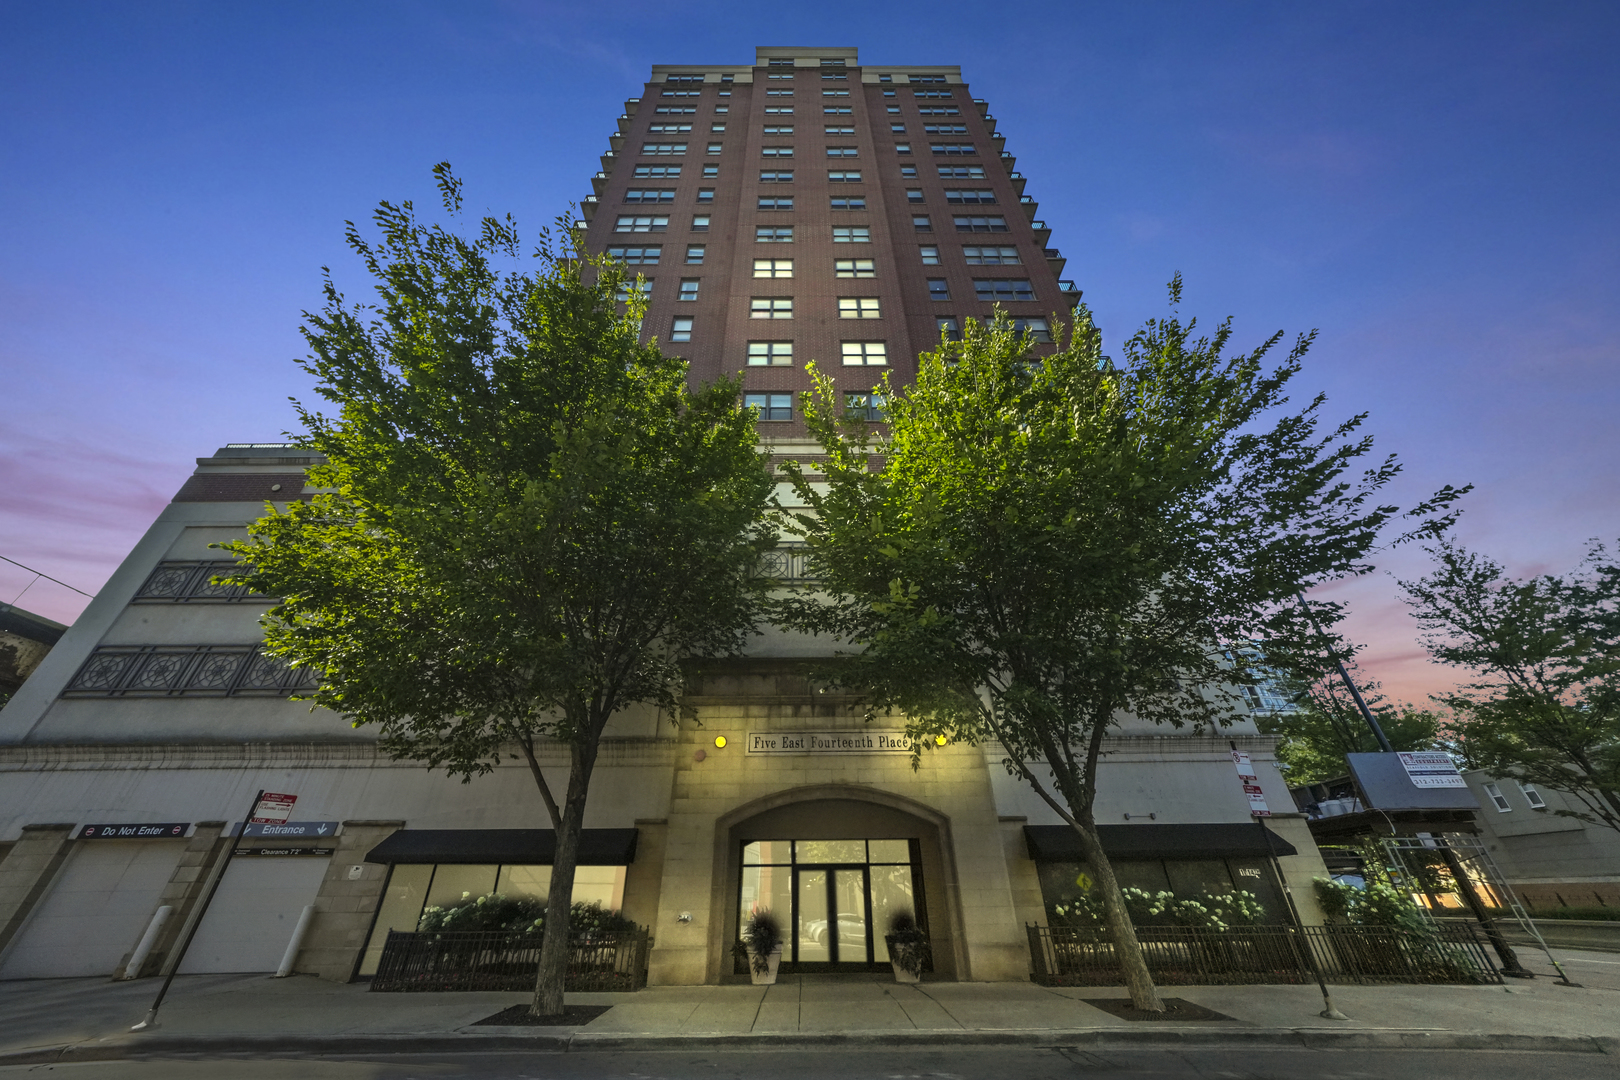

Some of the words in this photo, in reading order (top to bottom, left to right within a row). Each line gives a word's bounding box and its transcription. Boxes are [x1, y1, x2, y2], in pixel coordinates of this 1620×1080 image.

[753, 736, 777, 749] Five
[782, 736, 805, 749] East
[811, 735, 873, 748] Fourteenth
[878, 735, 908, 748] Place
[101, 827, 116, 836] Do
[118, 826, 136, 836] Not
[137, 826, 165, 836] Enter
[262, 825, 306, 834] Entrance
